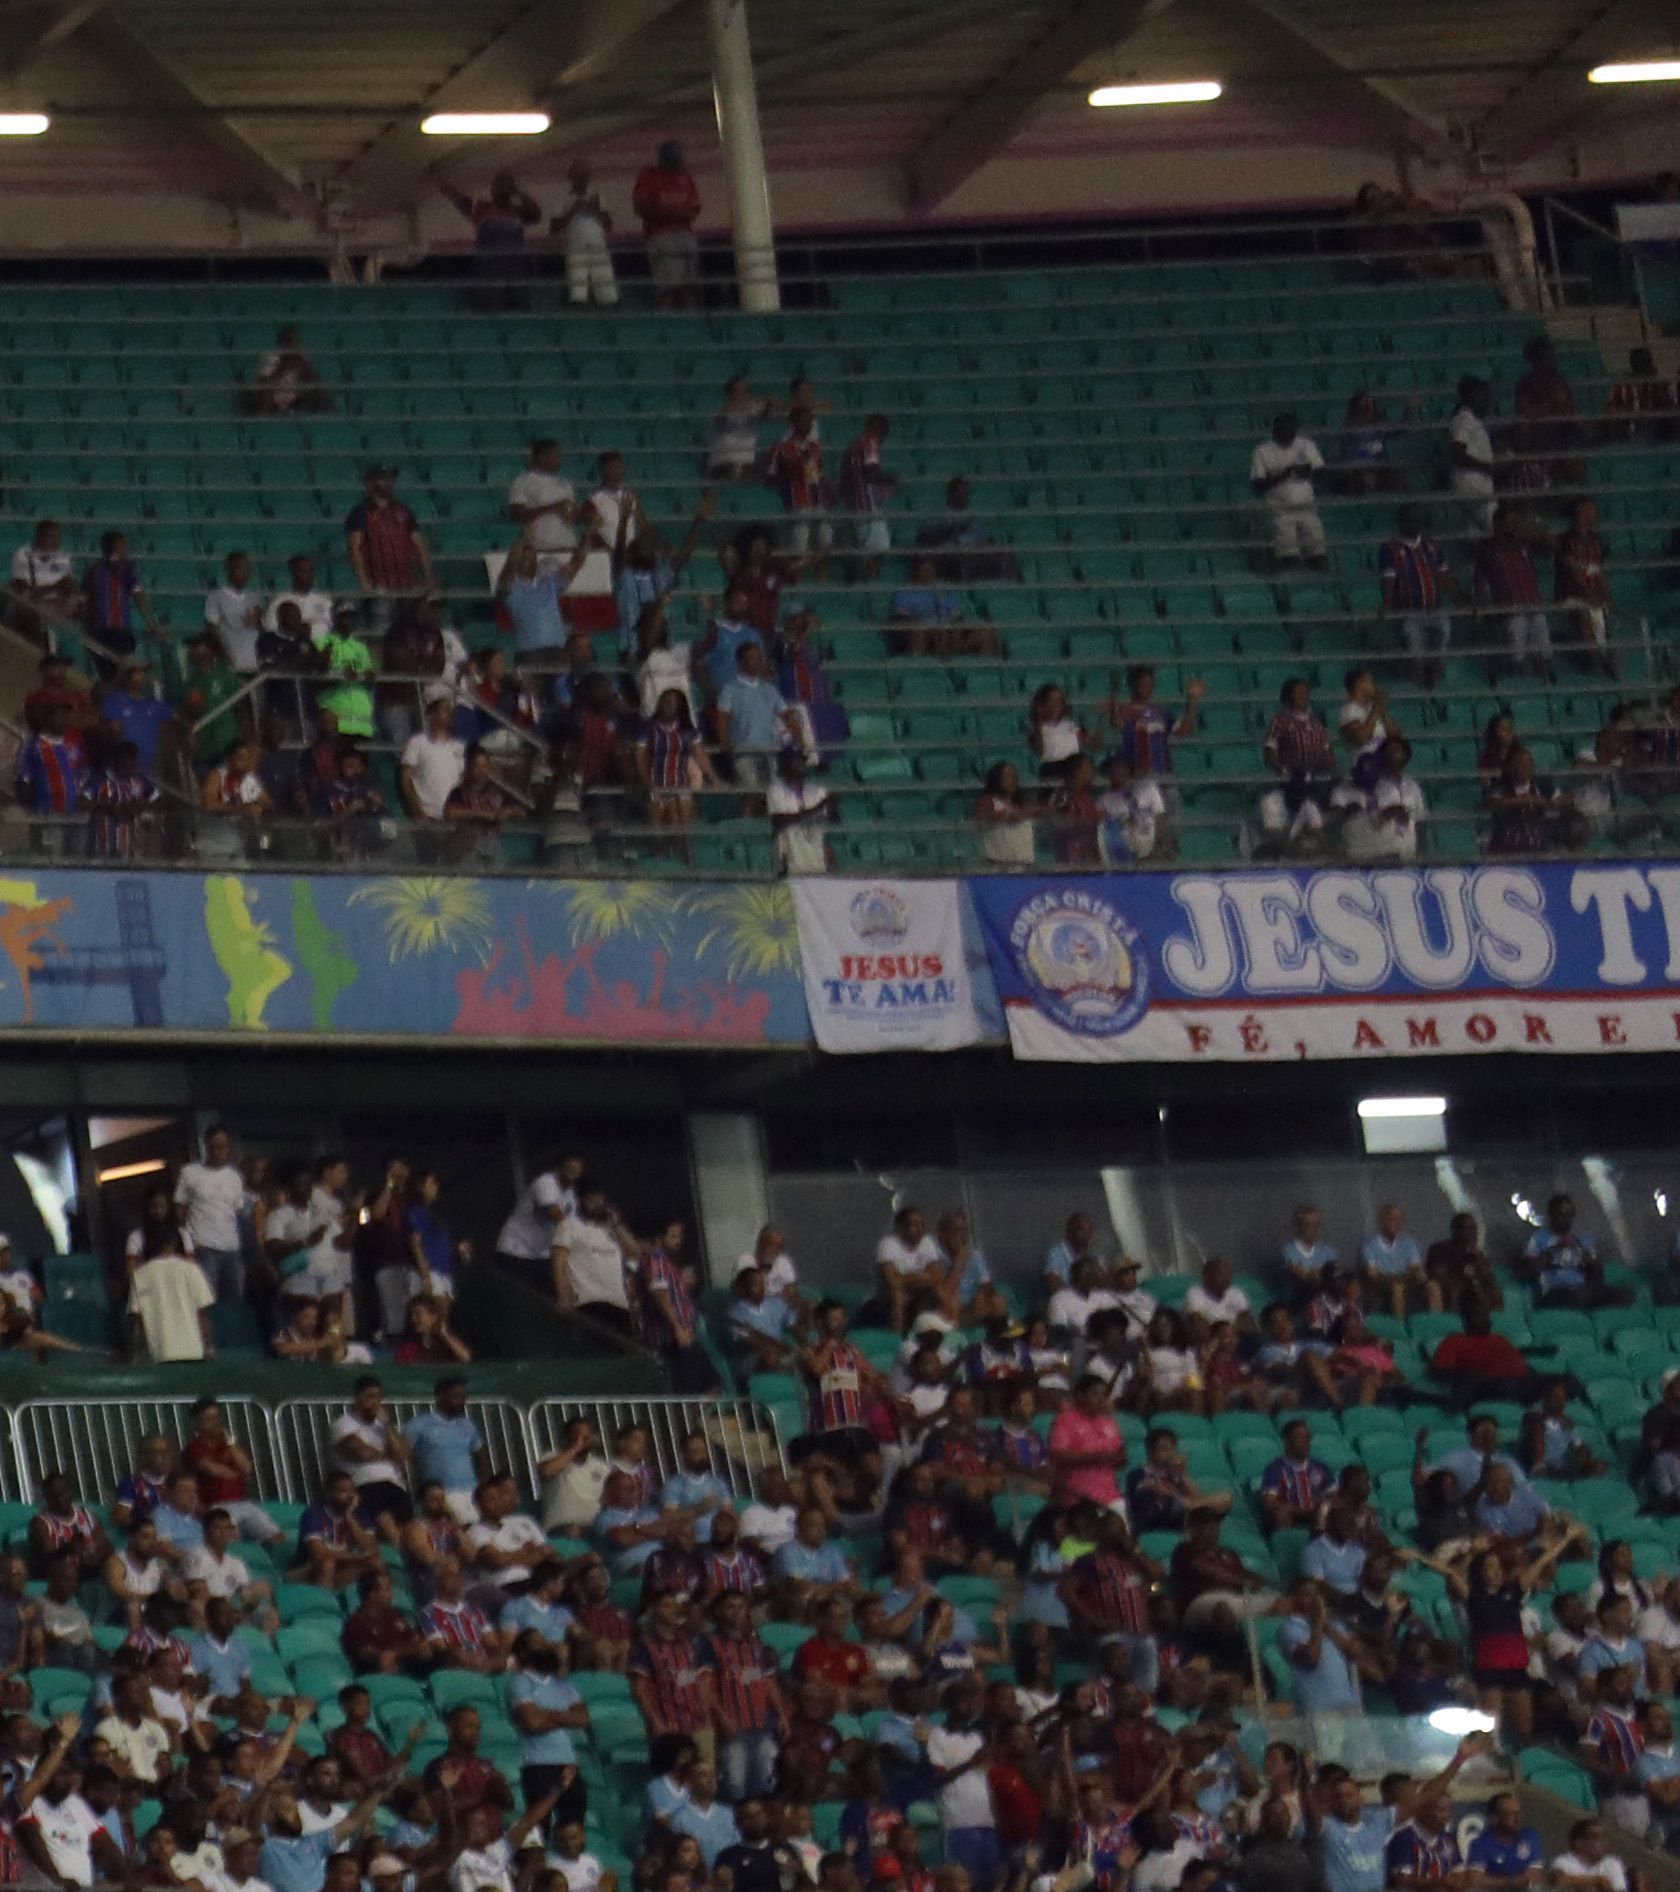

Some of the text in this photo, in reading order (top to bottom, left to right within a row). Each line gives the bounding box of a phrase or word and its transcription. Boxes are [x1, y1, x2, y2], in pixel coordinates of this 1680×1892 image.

[1163, 869, 1557, 997] JESUS
[840, 954, 943, 981] JESUS
[1351, 1012, 1554, 1051] AMOR
